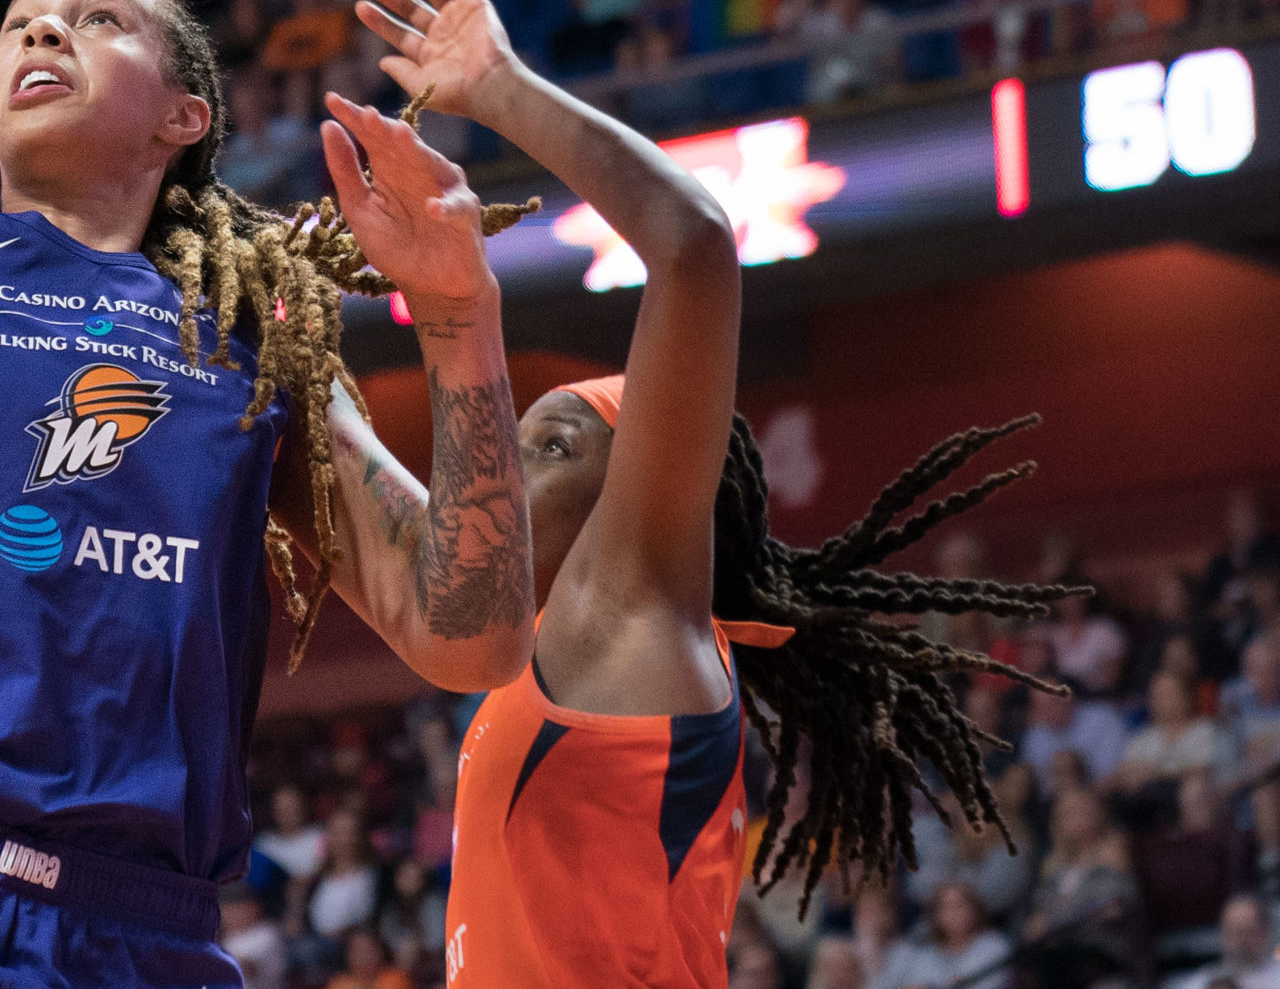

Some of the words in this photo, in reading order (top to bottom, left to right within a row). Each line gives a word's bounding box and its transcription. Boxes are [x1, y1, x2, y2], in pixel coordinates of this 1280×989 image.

[1083, 48, 1257, 191] 50
[92, 295, 198, 328] ARIZON
[75, 335, 138, 360] STICK
[141, 345, 219, 386] RESORT
[73, 525, 200, 584] AT&T
